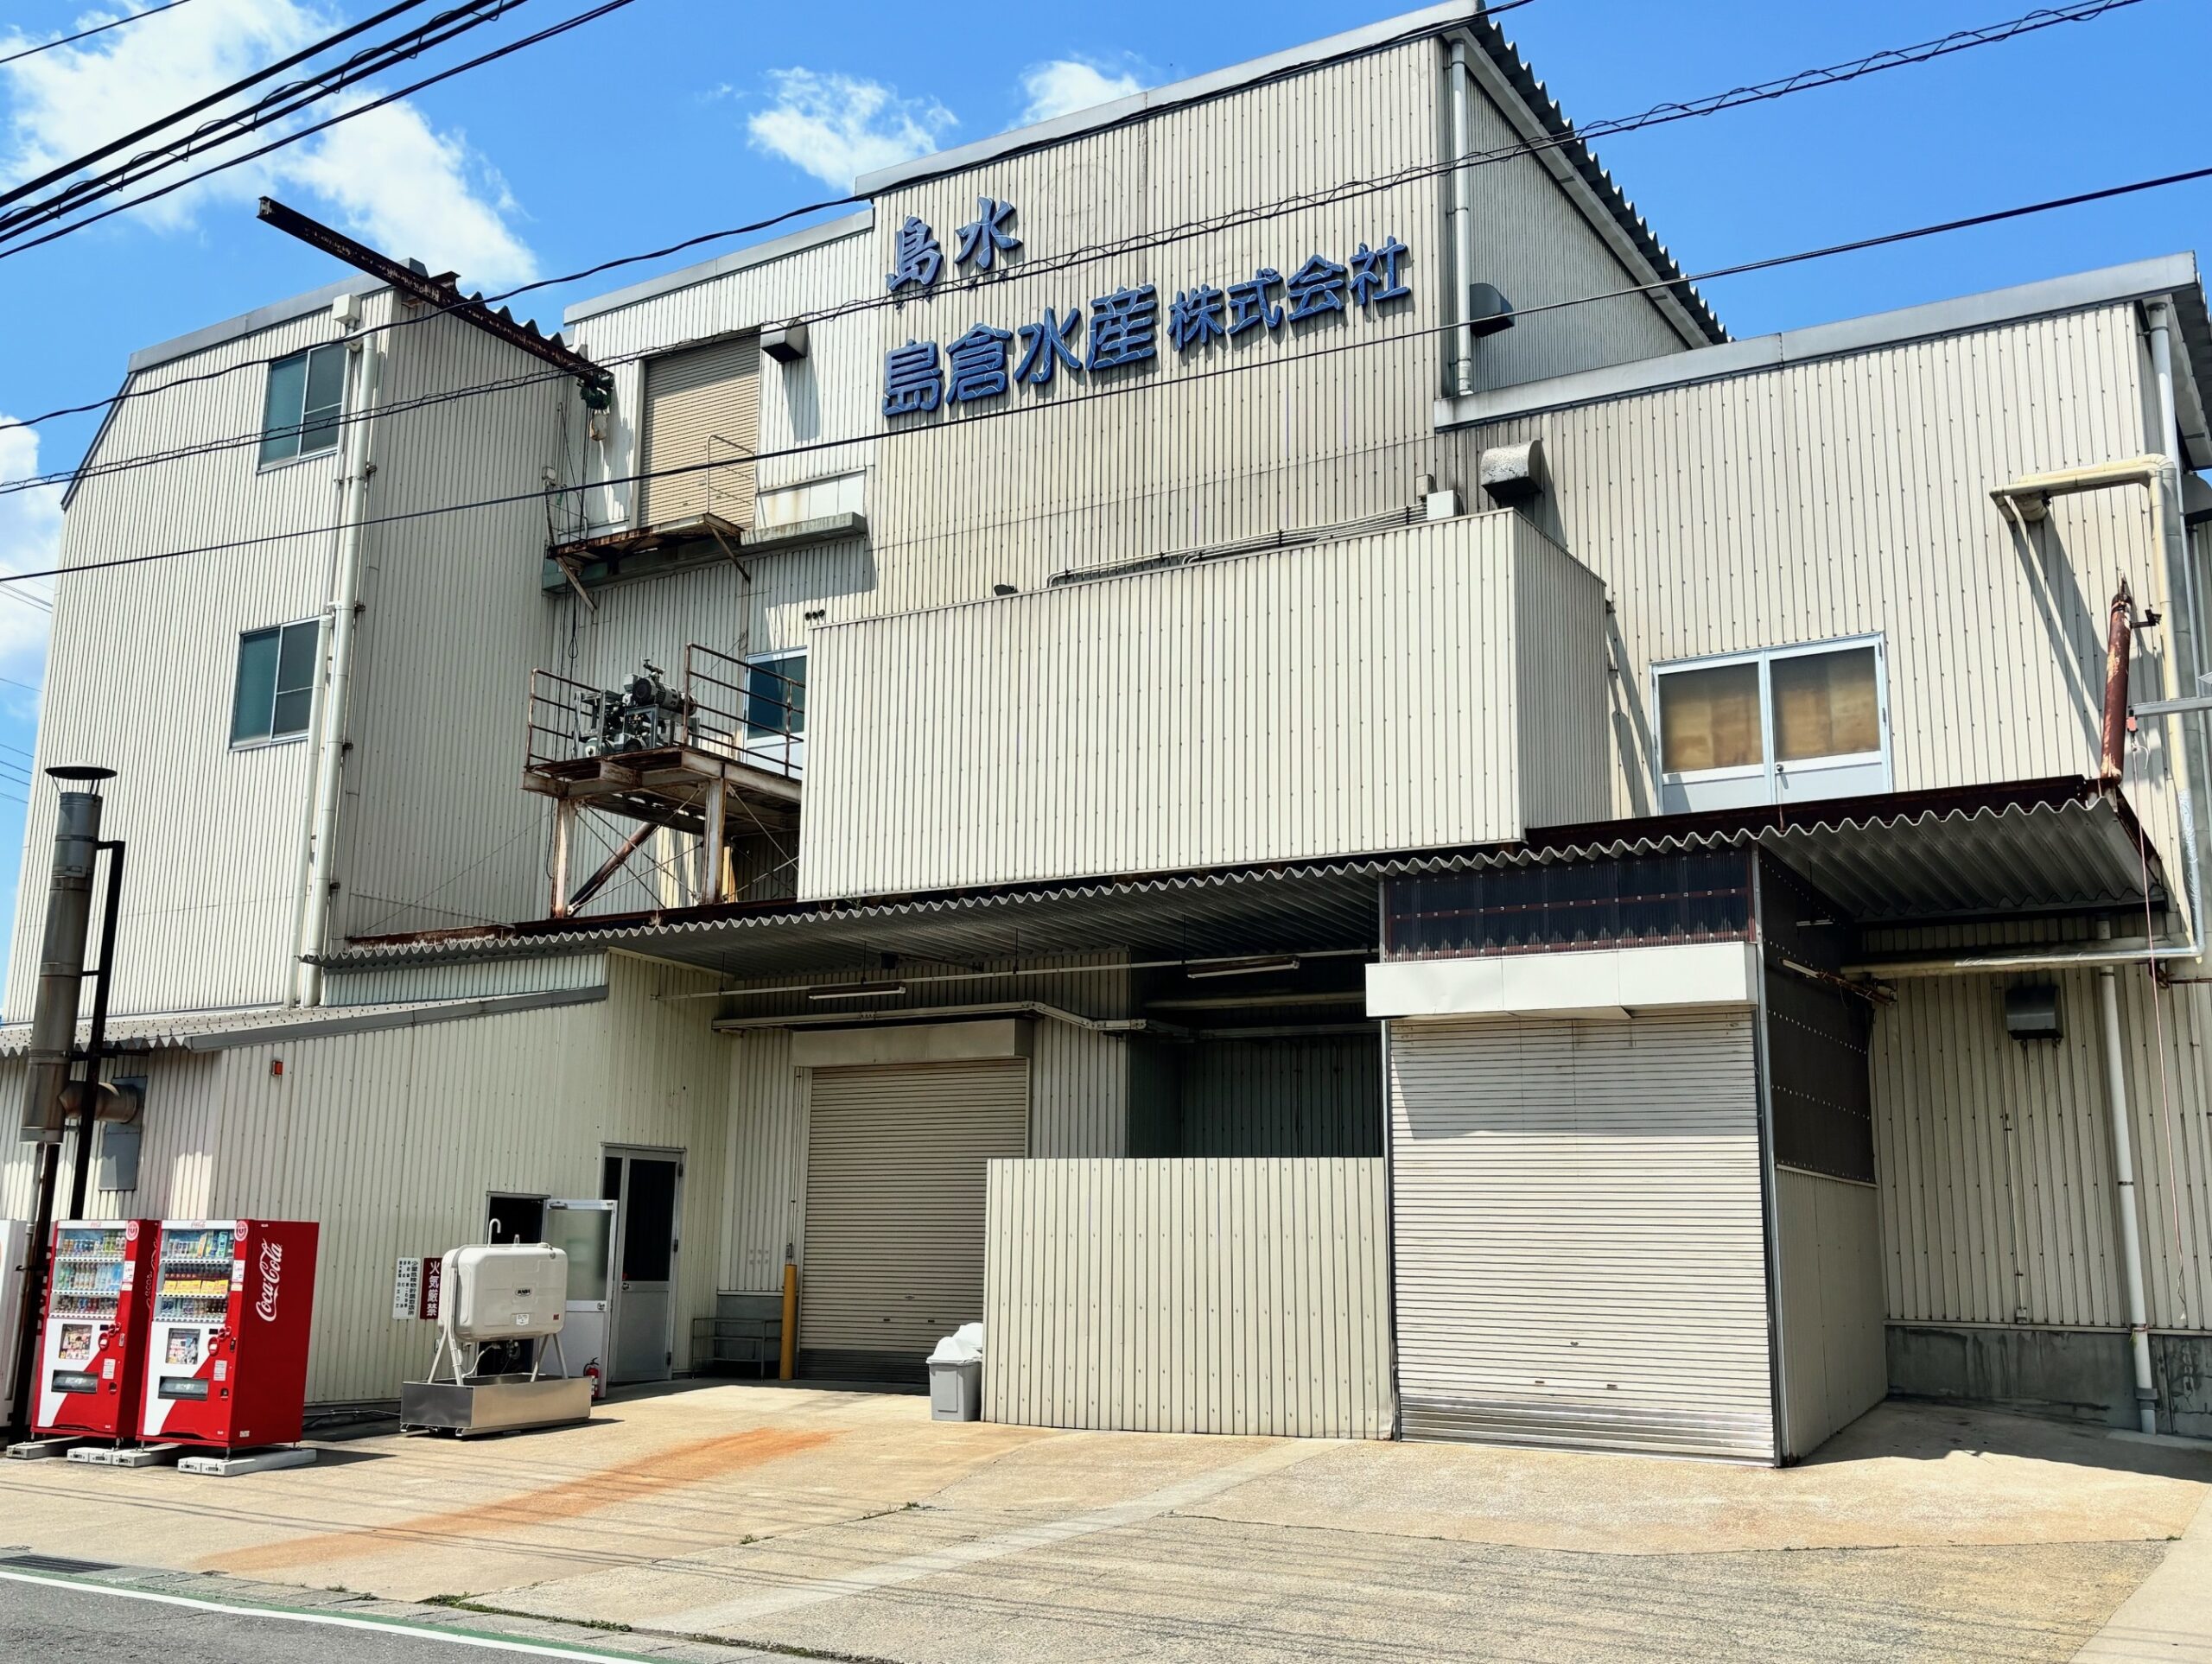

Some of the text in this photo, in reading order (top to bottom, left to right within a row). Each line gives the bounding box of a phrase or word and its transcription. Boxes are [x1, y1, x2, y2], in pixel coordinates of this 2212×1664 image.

[885, 196, 1023, 292] 島水
[882, 236, 1412, 416] 島倉水産株式会社
[256, 1238, 283, 1322] Coca-Cola
[427, 1261, 441, 1317] 火気厳禁
